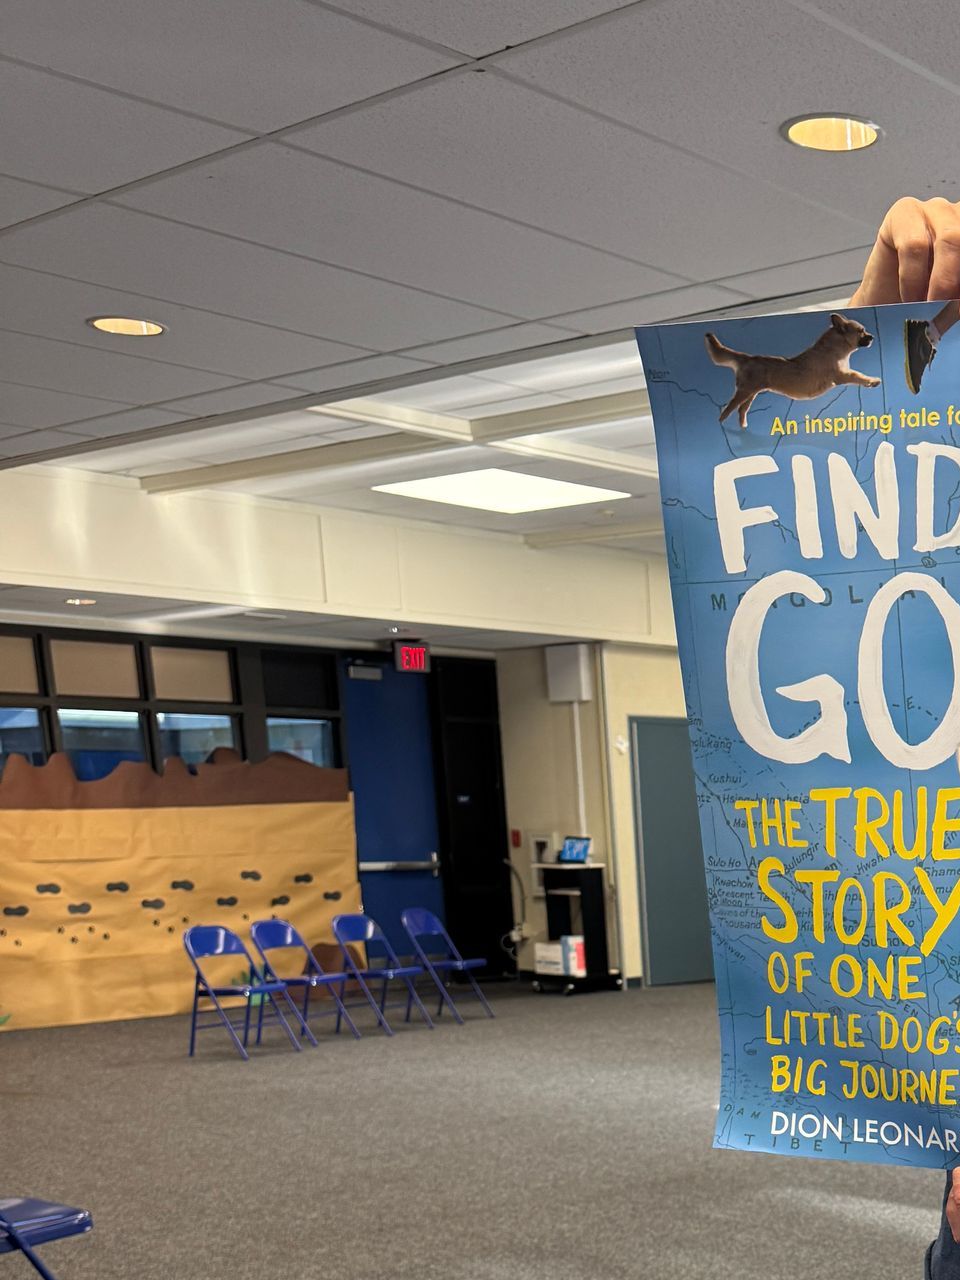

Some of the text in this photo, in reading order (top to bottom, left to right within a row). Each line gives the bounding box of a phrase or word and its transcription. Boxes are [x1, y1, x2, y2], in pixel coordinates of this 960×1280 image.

[771, 416, 798, 435] An
[804, 411, 893, 434] inspiring
[899, 407, 940, 428] tale
[401, 646, 426, 670] EXIT
[735, 798, 808, 848] THE
[767, 952, 926, 999] OF ONE
[765, 1006, 864, 1049] LITTLE
[771, 1055, 826, 1096] BIG
[744, 1134, 852, 1154] TIBET
[770, 1111, 843, 1142] DION
